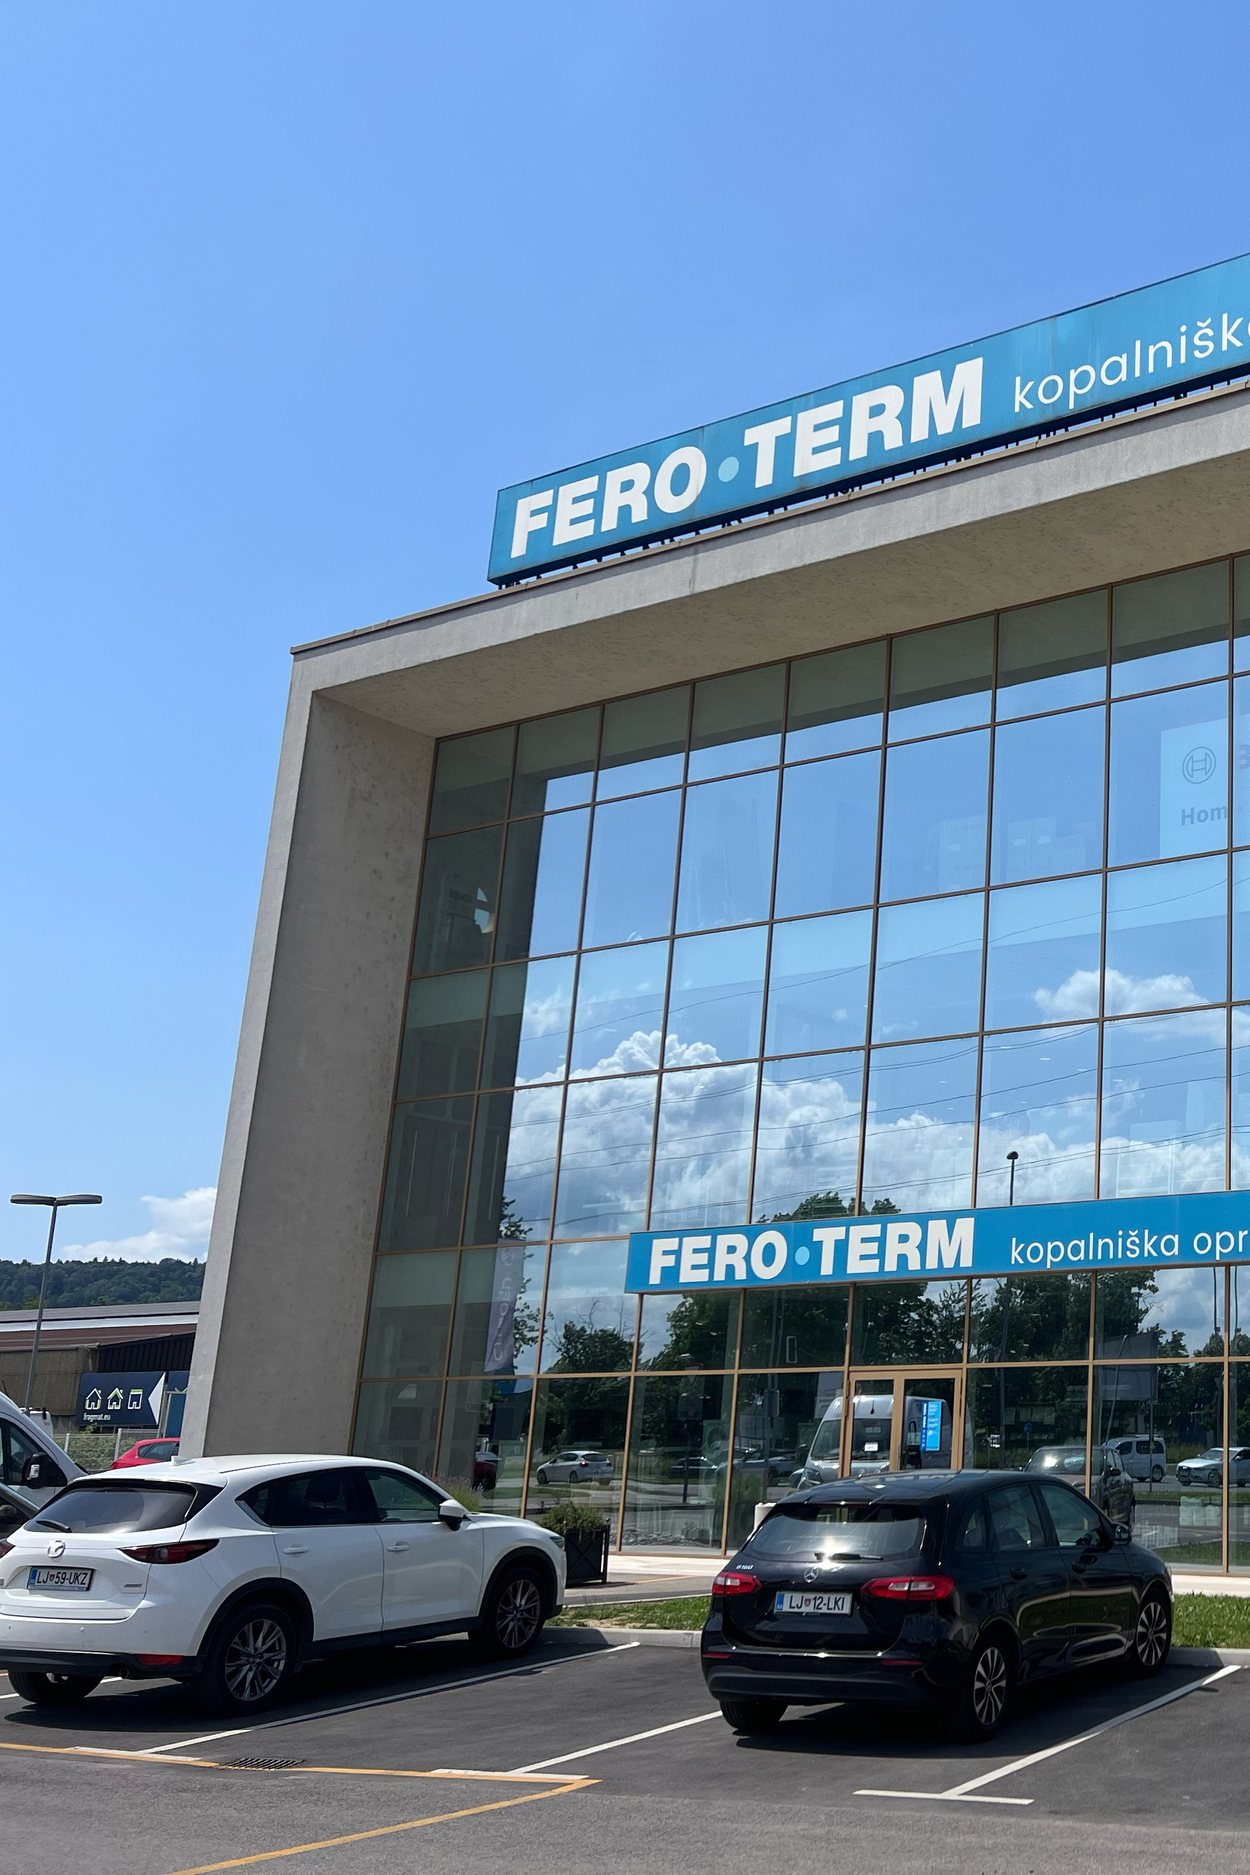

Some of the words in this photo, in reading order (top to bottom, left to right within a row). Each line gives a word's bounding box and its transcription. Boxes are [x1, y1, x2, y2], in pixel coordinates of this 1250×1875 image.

[1181, 804, 1241, 826] Hom
[1011, 1230, 1180, 1269] kopalniška
[83, 1412, 111, 1422] fragmat.eu
[55, 1571, 88, 1585] 59-UKZ
[812, 1595, 845, 1611] 12-LKI
